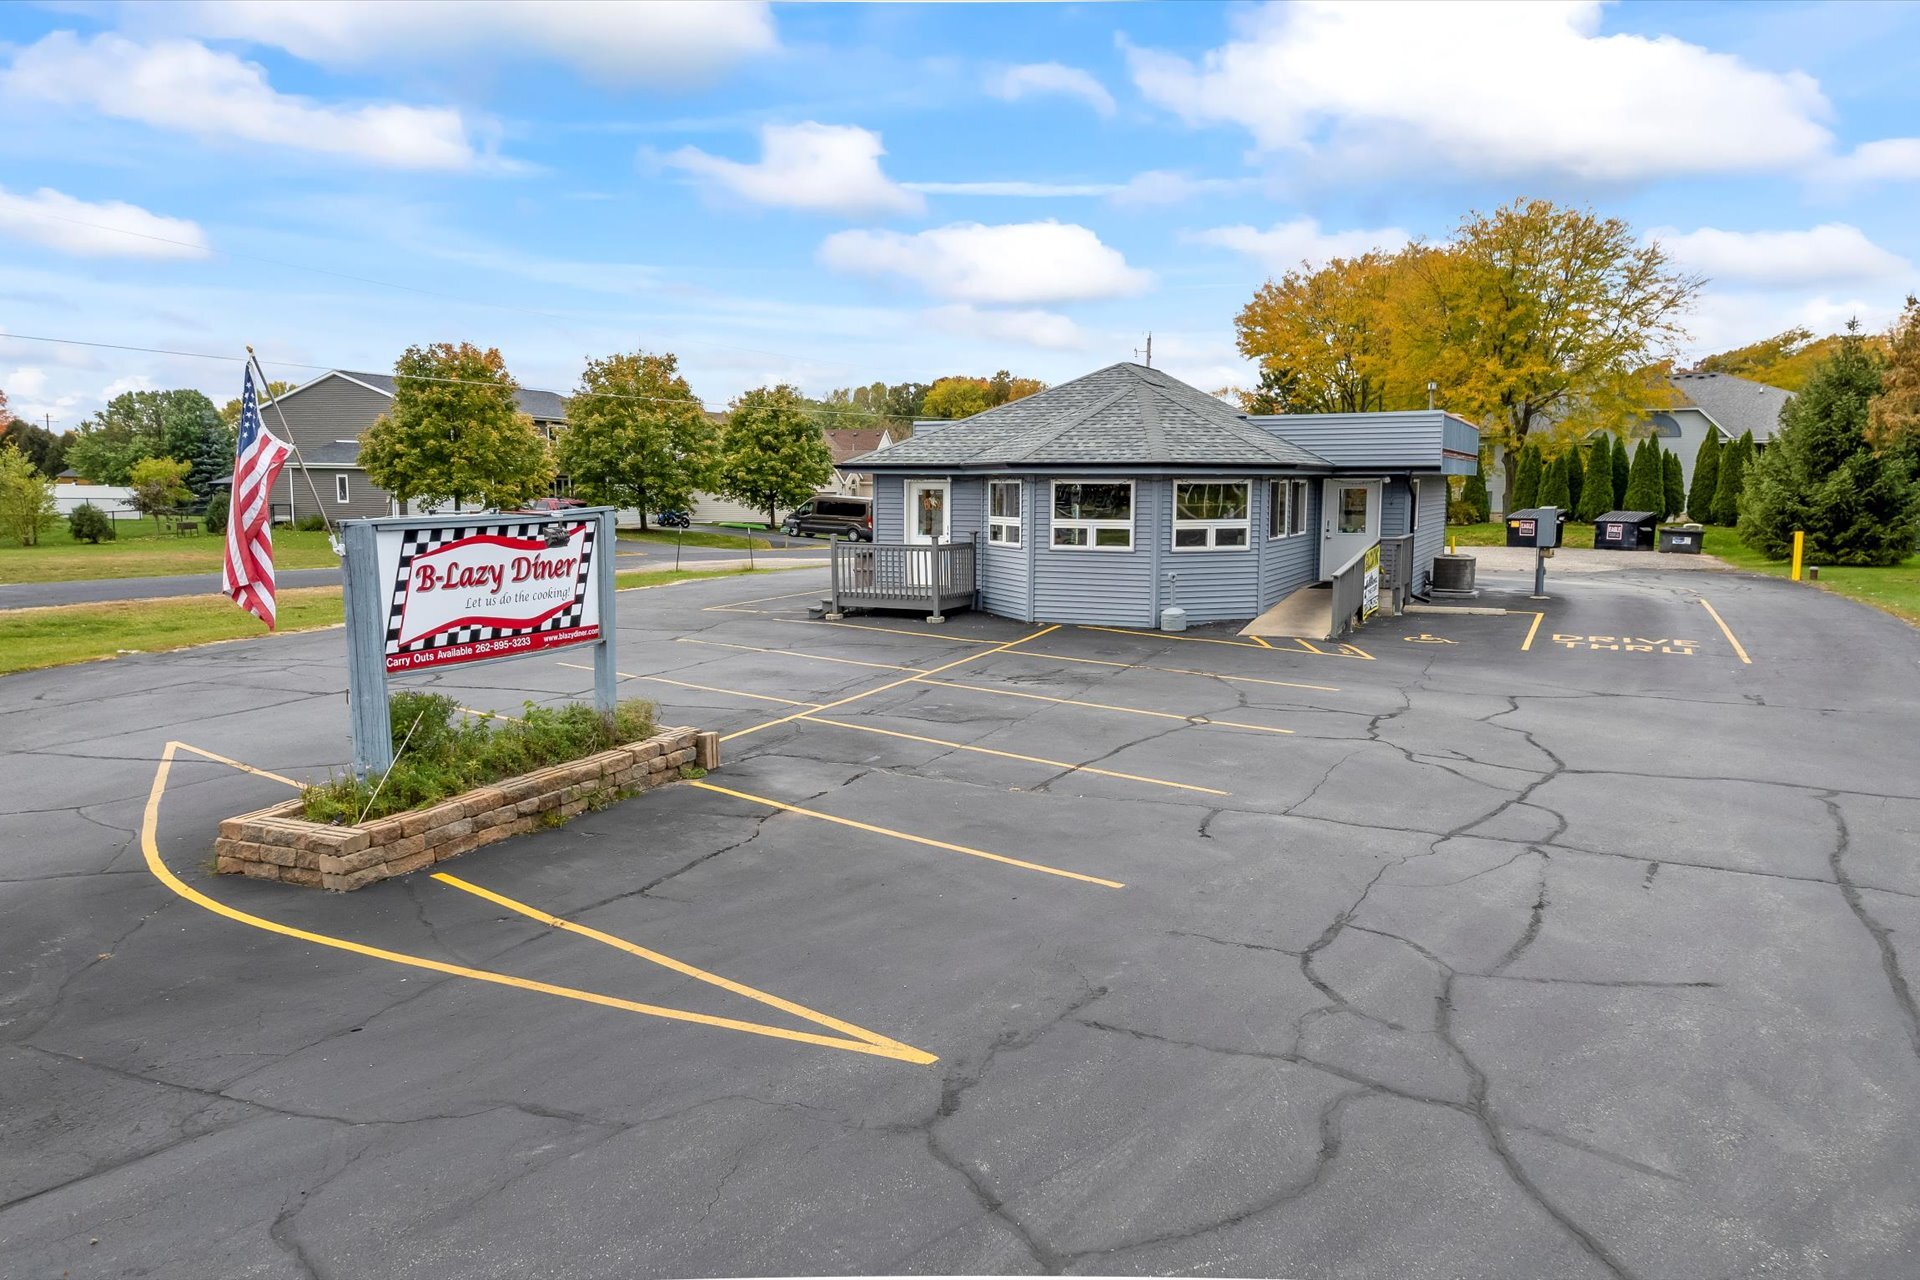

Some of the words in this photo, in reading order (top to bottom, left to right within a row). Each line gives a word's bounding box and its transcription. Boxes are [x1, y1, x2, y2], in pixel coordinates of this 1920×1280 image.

[416, 561, 505, 594] B-Lazy
[511, 553, 577, 582] Diner
[465, 597, 481, 609] Let
[485, 596, 497, 607] us
[500, 593, 511, 605] do
[514, 591, 530, 604] the
[532, 587, 571, 601] cooking!
[1552, 634, 1700, 647] DRIVE
[1554, 641, 1693, 655] THRU
[386, 656, 410, 668] Carry
[413, 651, 434, 664] Outs
[437, 646, 473, 659] Available
[475, 637, 531, 654] 262-895-3233
